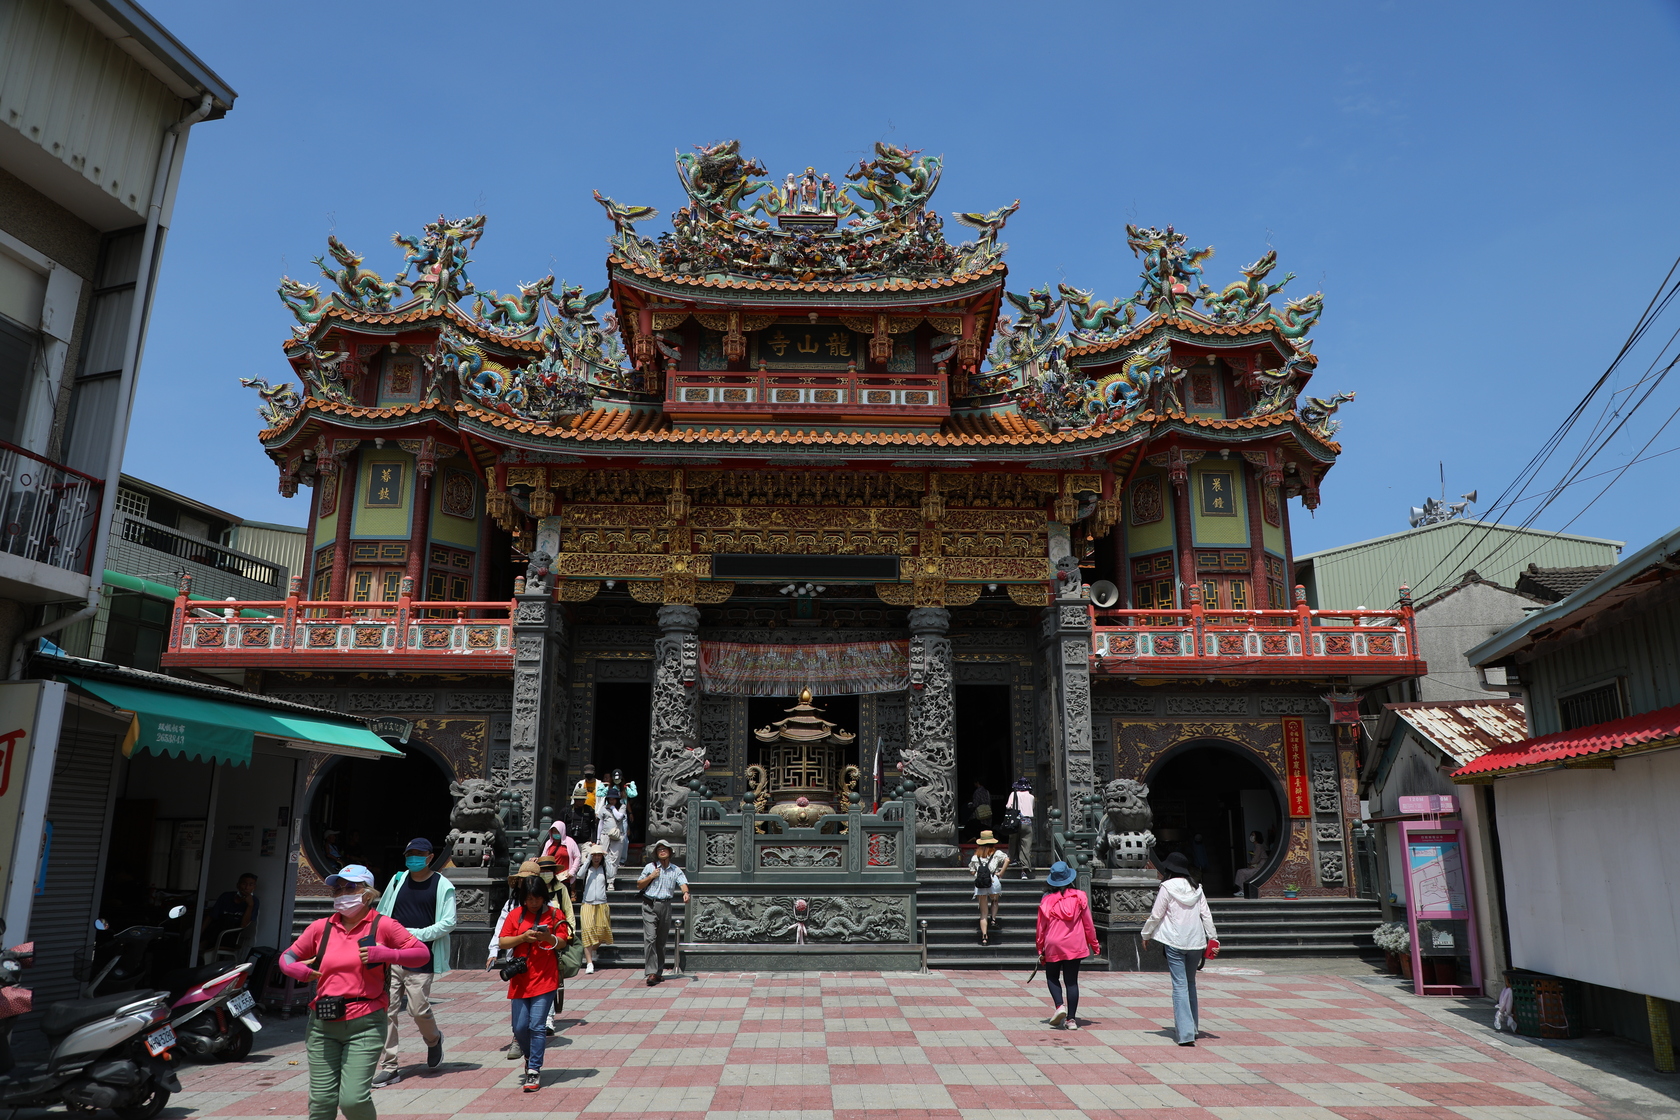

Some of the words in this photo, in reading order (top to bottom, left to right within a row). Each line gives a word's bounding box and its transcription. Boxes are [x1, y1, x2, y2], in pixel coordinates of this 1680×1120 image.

[767, 330, 851, 357] 龍山寺
[378, 468, 392, 500] 暮鼓
[1212, 477, 1225, 509] 晨鐘
